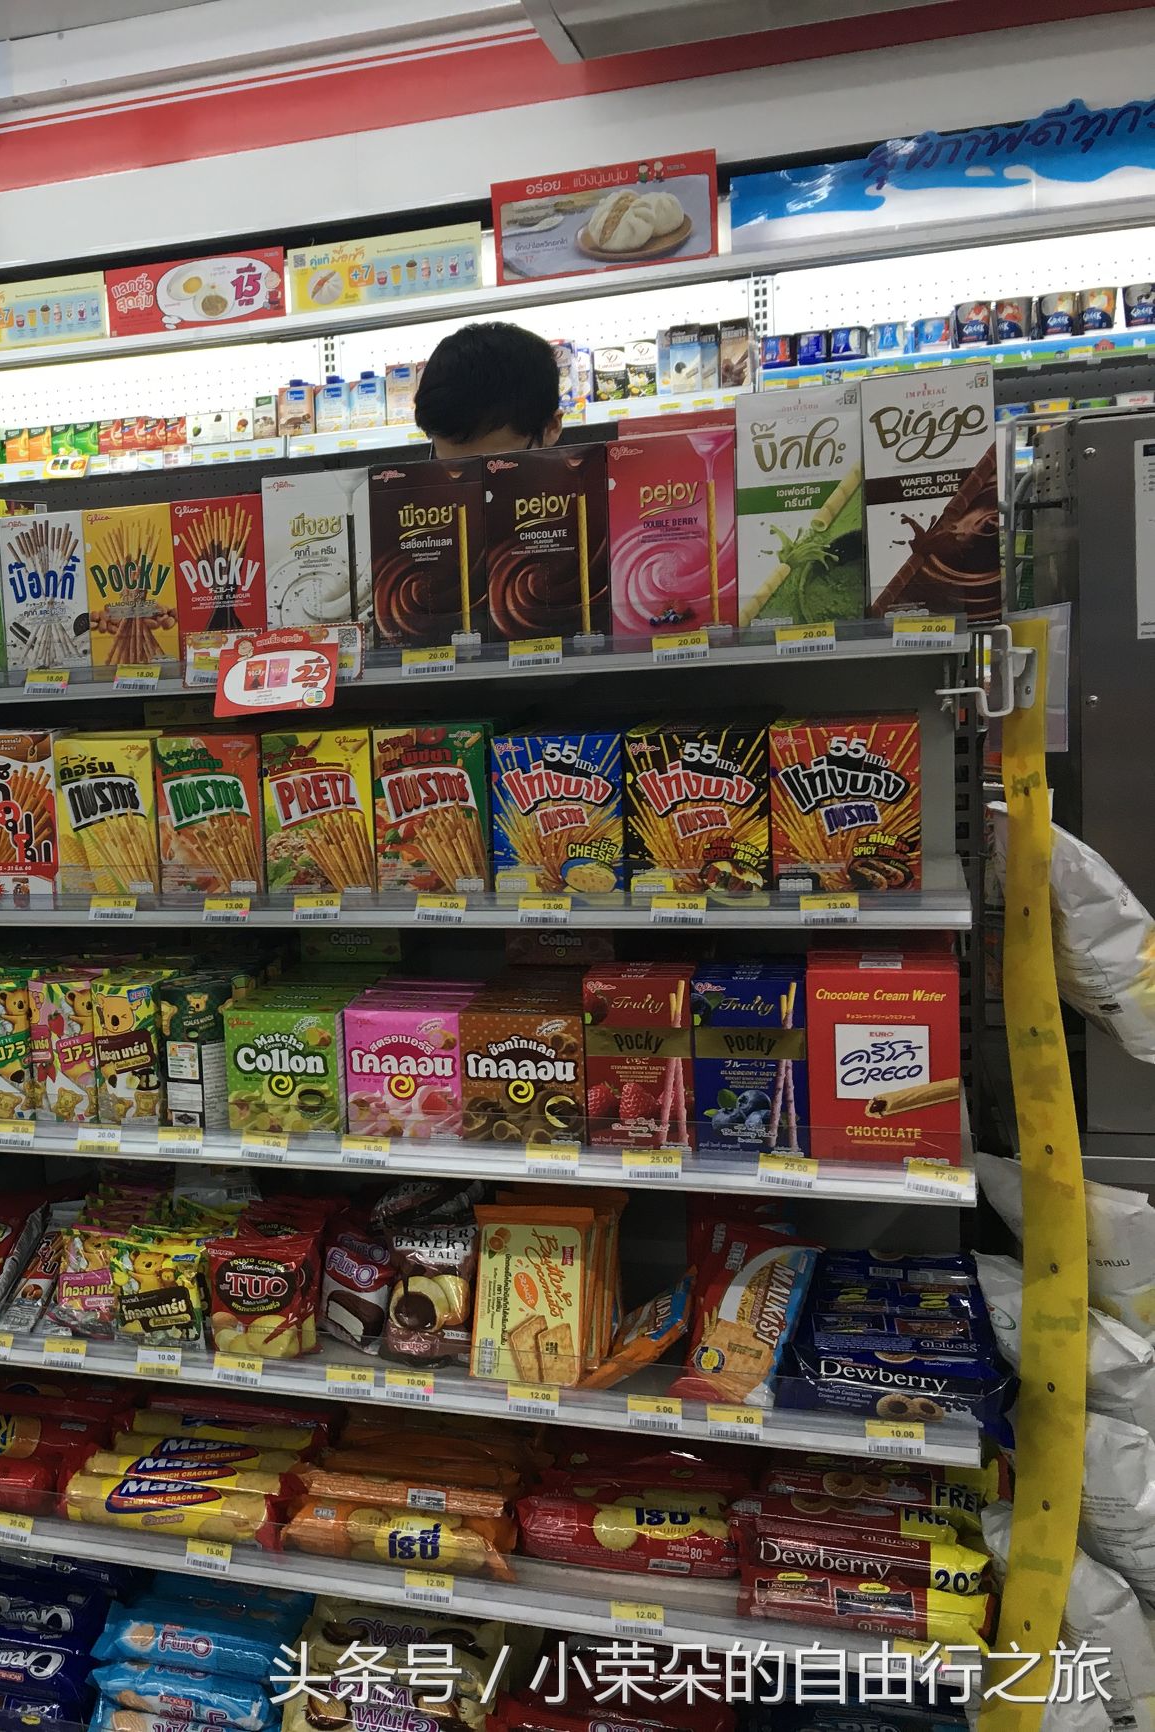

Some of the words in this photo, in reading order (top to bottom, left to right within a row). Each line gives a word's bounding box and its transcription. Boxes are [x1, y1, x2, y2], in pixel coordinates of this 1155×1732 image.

[349, 264, 372, 281] +7
[231, 271, 262, 300] 15
[905, 387, 947, 399] IMPERIAL
[869, 404, 988, 463] Biggo
[900, 476, 933, 488] WAFER
[936, 473, 961, 483] ROLL
[639, 480, 699, 507] pejoy
[902, 483, 959, 498] CHOCOLATE
[515, 492, 570, 520] pejoy
[643, 518, 671, 529] DOUBLE
[673, 516, 699, 527] BERRY
[519, 529, 568, 540] CHOCOLATE
[89, 555, 171, 598] Pocky
[179, 551, 261, 593] Pocky
[191, 595, 224, 603] CHOCOLATE
[803, 630, 827, 639] 20.00
[921, 624, 946, 633] 20.00
[533, 644, 554, 652] 20.00
[678, 636, 701, 646] 20.00
[428, 652, 449, 660] 20.00
[136, 670, 154, 678] 18.00
[292, 664, 330, 683] 25
[545, 743, 578, 763] 55
[683, 742, 718, 764] 55
[829, 736, 867, 757] 55
[276, 772, 357, 820] PRETZ
[568, 843, 614, 864] CHEESE
[735, 851, 759, 867] BBQ
[853, 846, 877, 857] SPICY
[676, 902, 698, 910] 13.00
[827, 902, 850, 910] 13.00
[815, 988, 870, 1003] Chocolate
[873, 990, 909, 1002] Cream
[912, 989, 946, 1003] Wafer
[611, 995, 665, 1014] Fruity
[718, 997, 775, 1016] Fruity
[254, 1032, 305, 1051] Matcha
[614, 1031, 665, 1055] Pocky
[723, 1032, 777, 1055] Pocky
[236, 1046, 325, 1074] Collon
[351, 1048, 453, 1079] โคลลอน
[466, 1052, 575, 1082] โคลลอน
[841, 1064, 922, 1086] CRECO
[97, 1131, 115, 1139] 20.00
[845, 1125, 922, 1139] CHOCOLATE
[650, 1155, 673, 1164] 25.00
[784, 1162, 808, 1173] 25.00
[395, 1234, 471, 1249] BAKERY
[429, 1250, 460, 1262] BALL
[225, 1272, 289, 1299] TUO
[753, 1261, 797, 1350] MALKIST
[237, 1362, 256, 1370] 10.00
[406, 1377, 426, 1386] 10.00
[820, 1359, 948, 1395] Dewberry
[530, 1391, 551, 1400] 12.00
[656, 1405, 673, 1414] 5.00
[736, 1415, 754, 1424] 5.00
[890, 1429, 914, 1439] 10.00
[180, 1468, 219, 1478] CRACKER
[164, 1492, 204, 1502] CRACKER
[935, 1485, 977, 1513] FRE
[690, 1548, 703, 1560] 80
[760, 1538, 892, 1580] Dewberry
[425, 1579, 445, 1587] 12.00
[636, 1611, 657, 1619] 12.00
